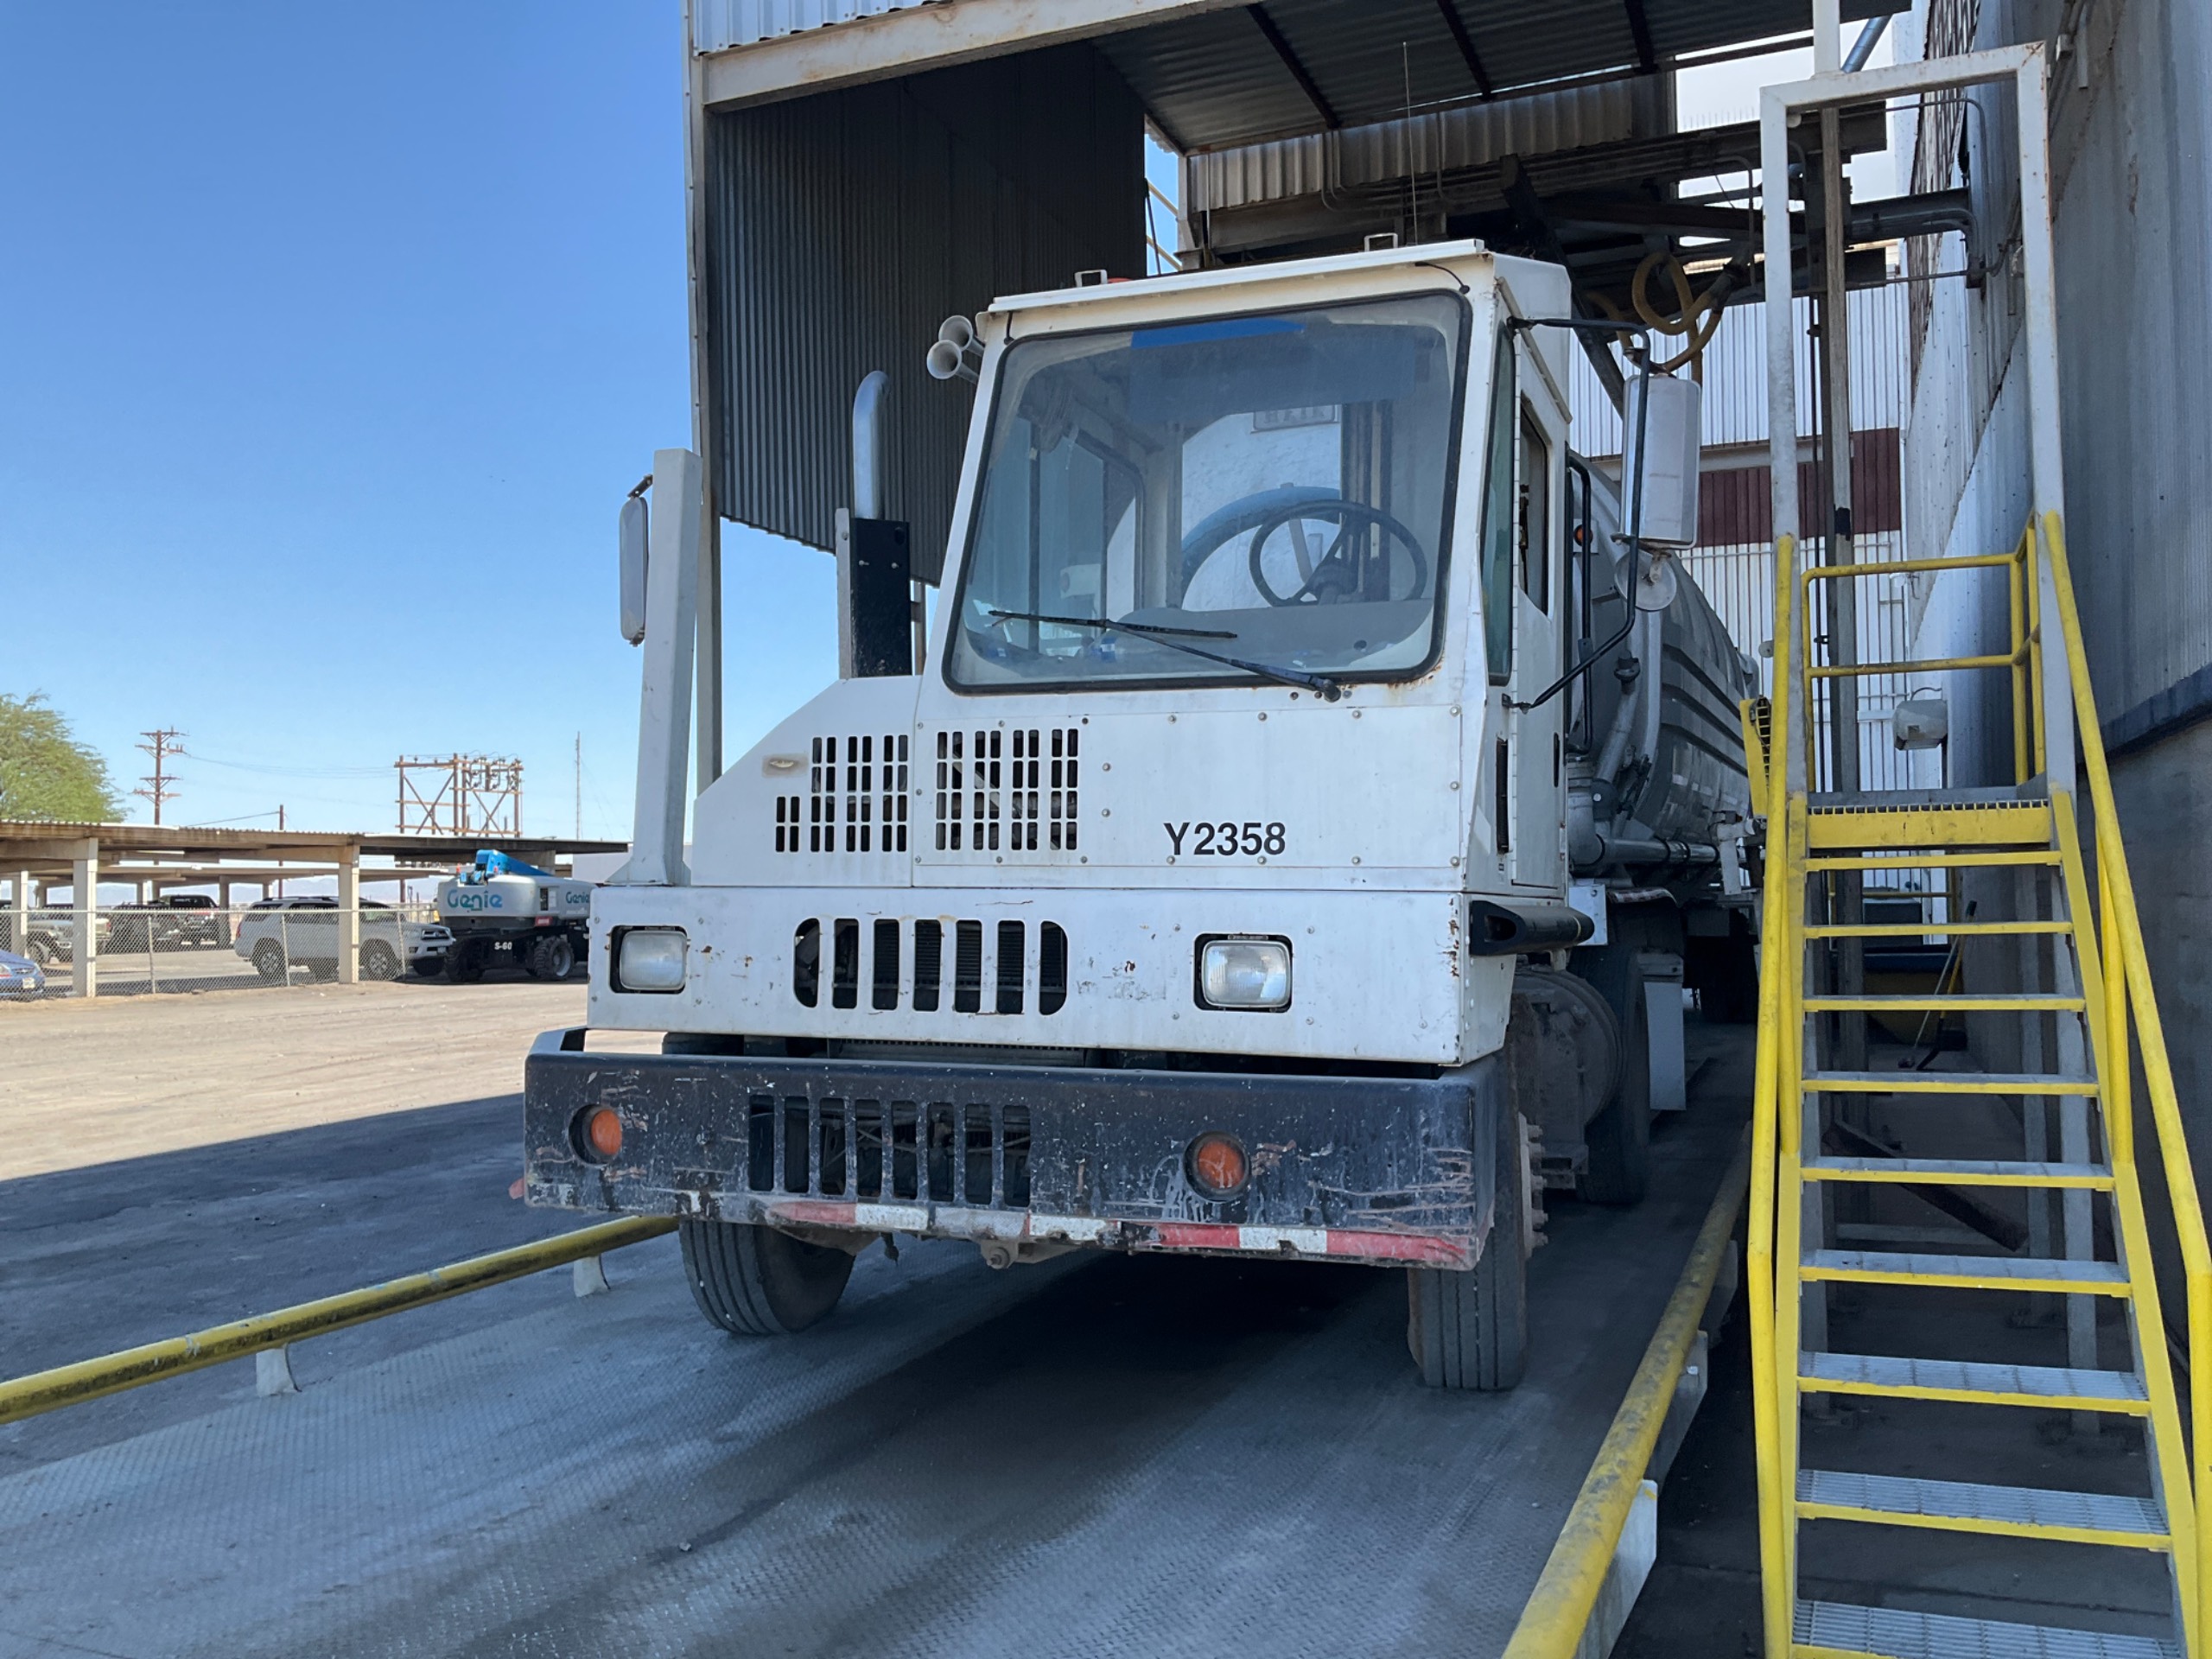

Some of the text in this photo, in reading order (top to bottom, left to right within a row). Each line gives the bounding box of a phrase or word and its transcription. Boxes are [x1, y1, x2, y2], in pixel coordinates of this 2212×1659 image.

[1163, 822, 1286, 855] Y2358
[447, 889, 503, 911] Genie
[565, 892, 589, 904] Genie
[494, 942, 512, 950] S-60
